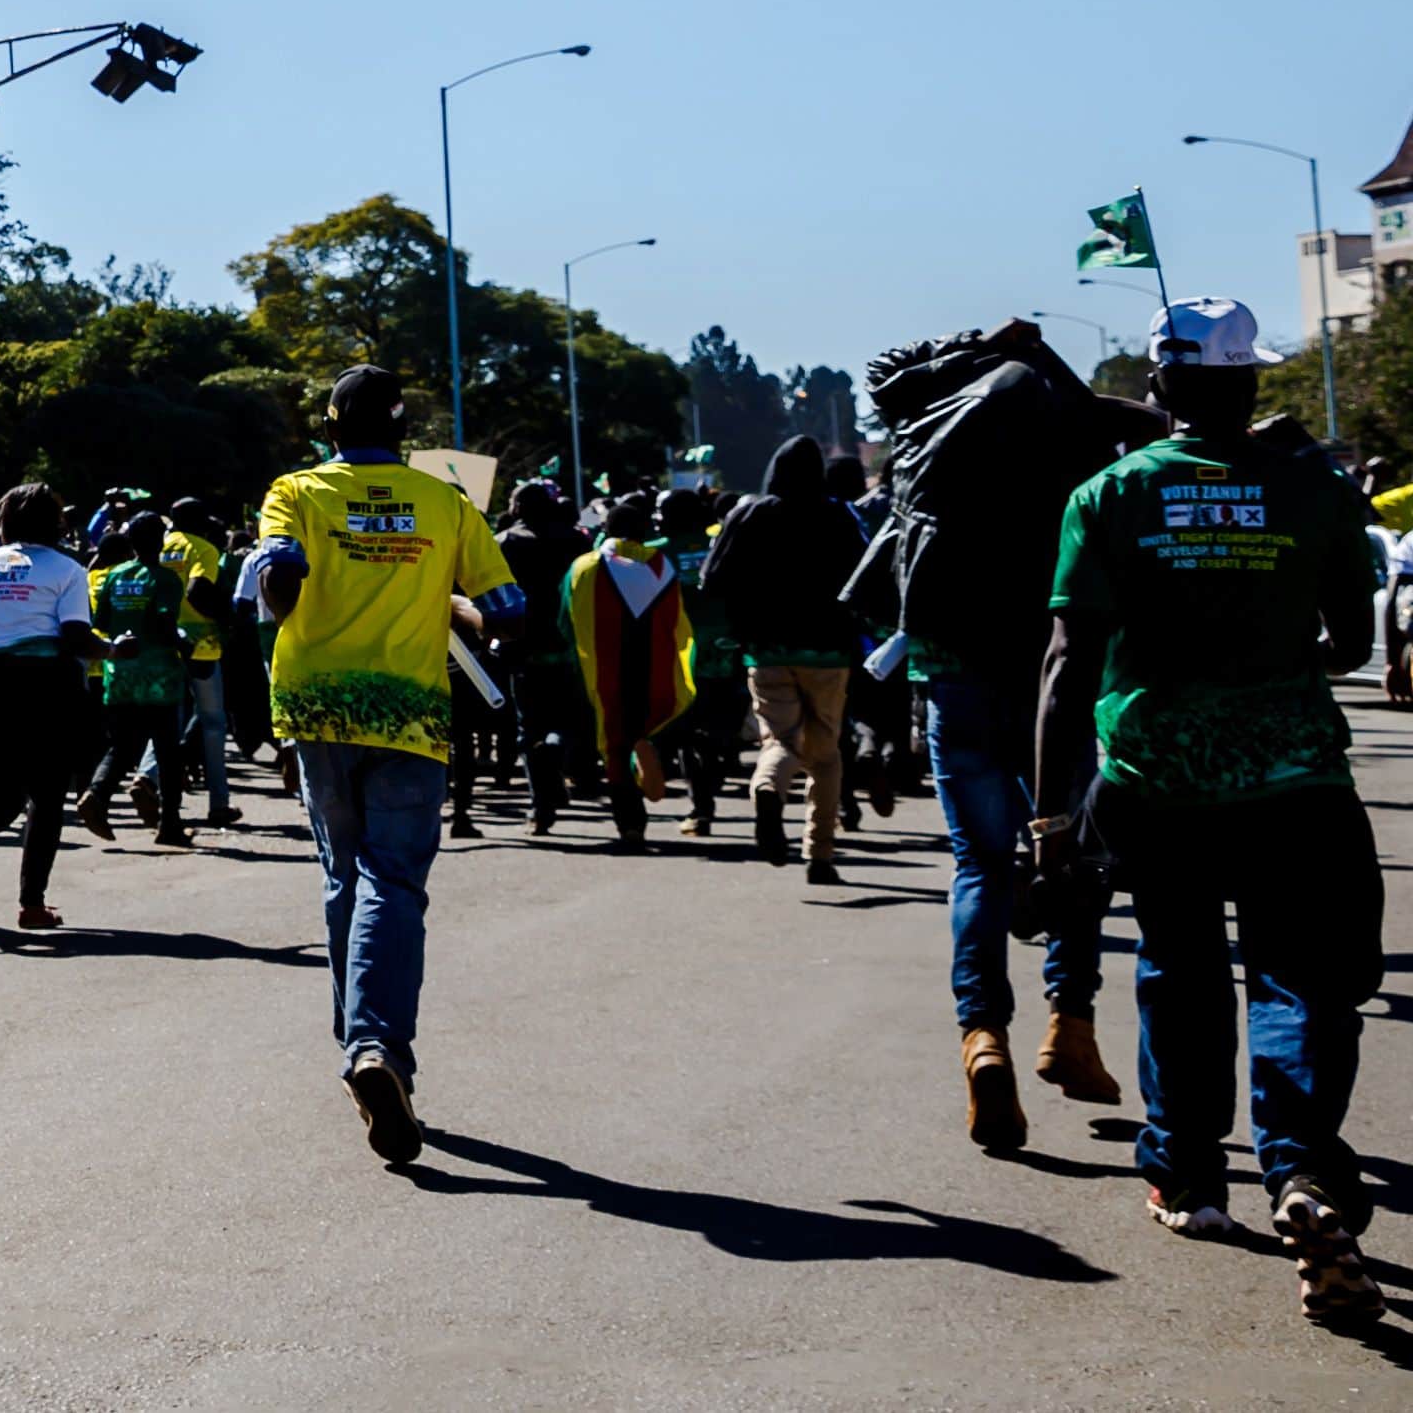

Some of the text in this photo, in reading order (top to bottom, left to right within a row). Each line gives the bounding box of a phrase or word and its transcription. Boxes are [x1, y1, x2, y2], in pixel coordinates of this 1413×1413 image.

[1160, 485, 1263, 501] VOTE ZANU PF
